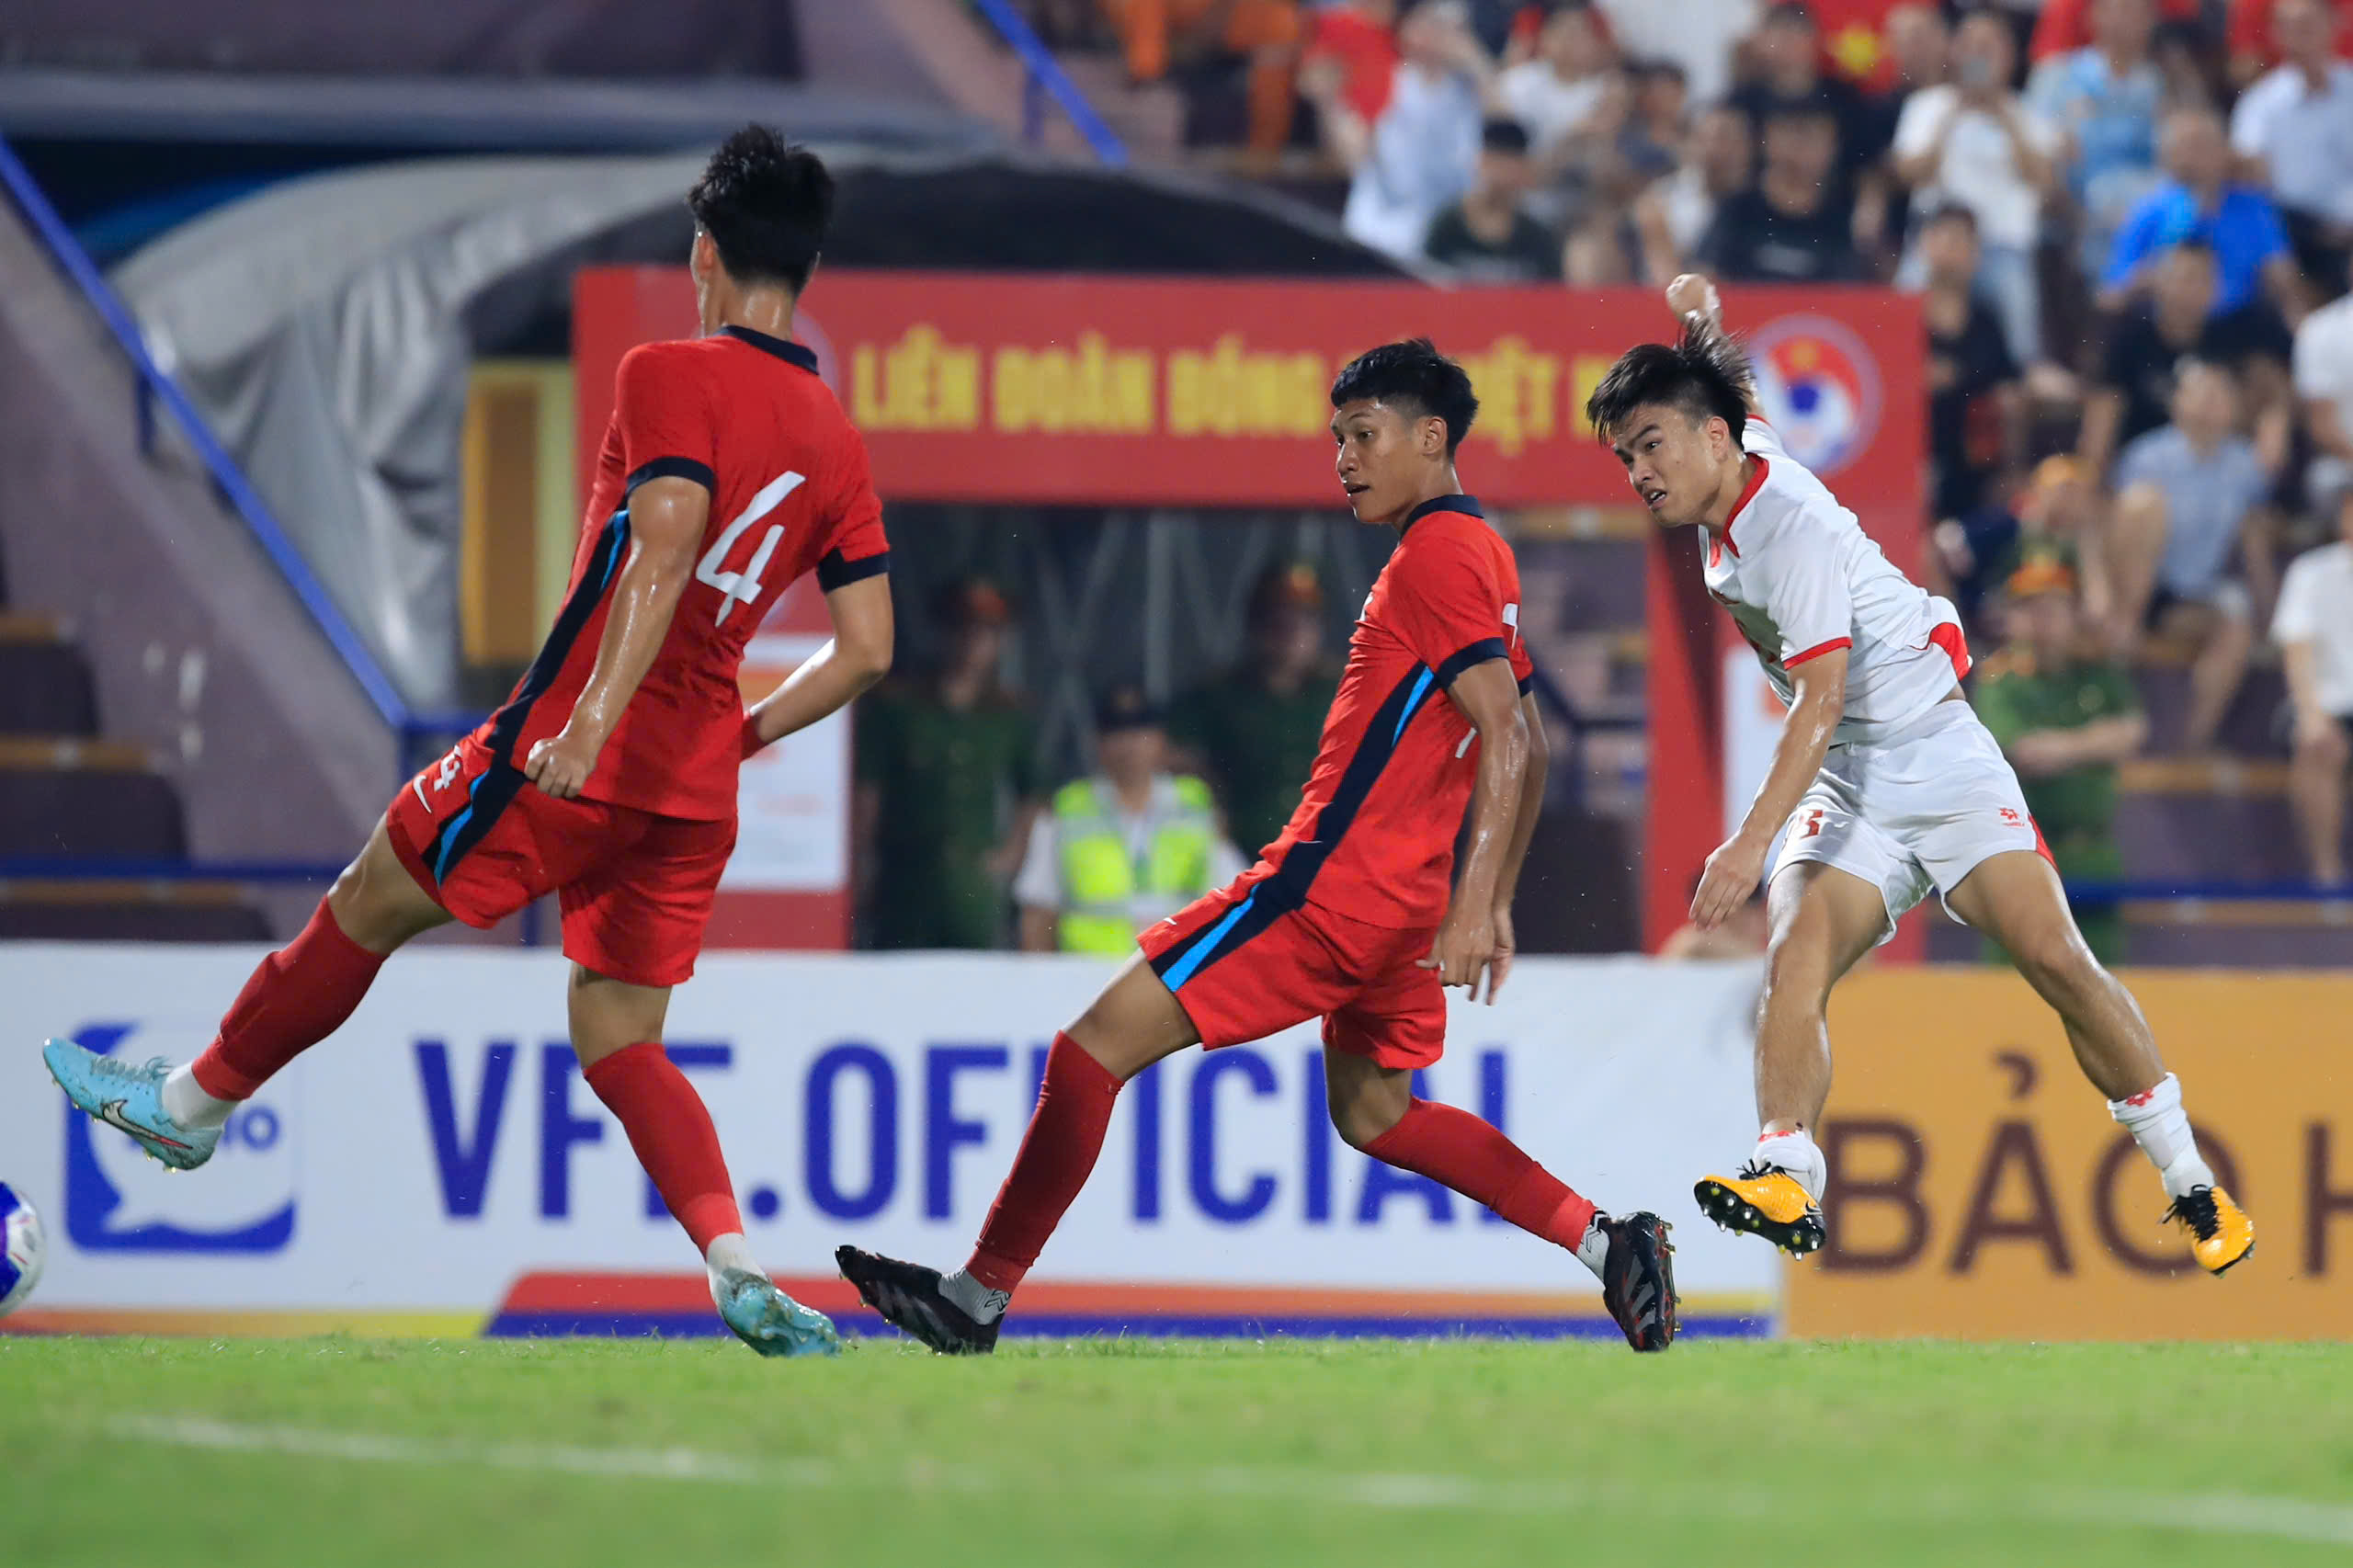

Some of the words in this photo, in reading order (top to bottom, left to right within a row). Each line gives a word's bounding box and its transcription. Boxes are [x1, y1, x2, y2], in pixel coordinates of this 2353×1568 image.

[853, 324, 978, 430] LIÊN
[1469, 335, 1558, 456] IỆT
[696, 471, 806, 628] 4
[434, 744, 462, 792] 4
[1820, 1048, 2245, 1276] BẢO
